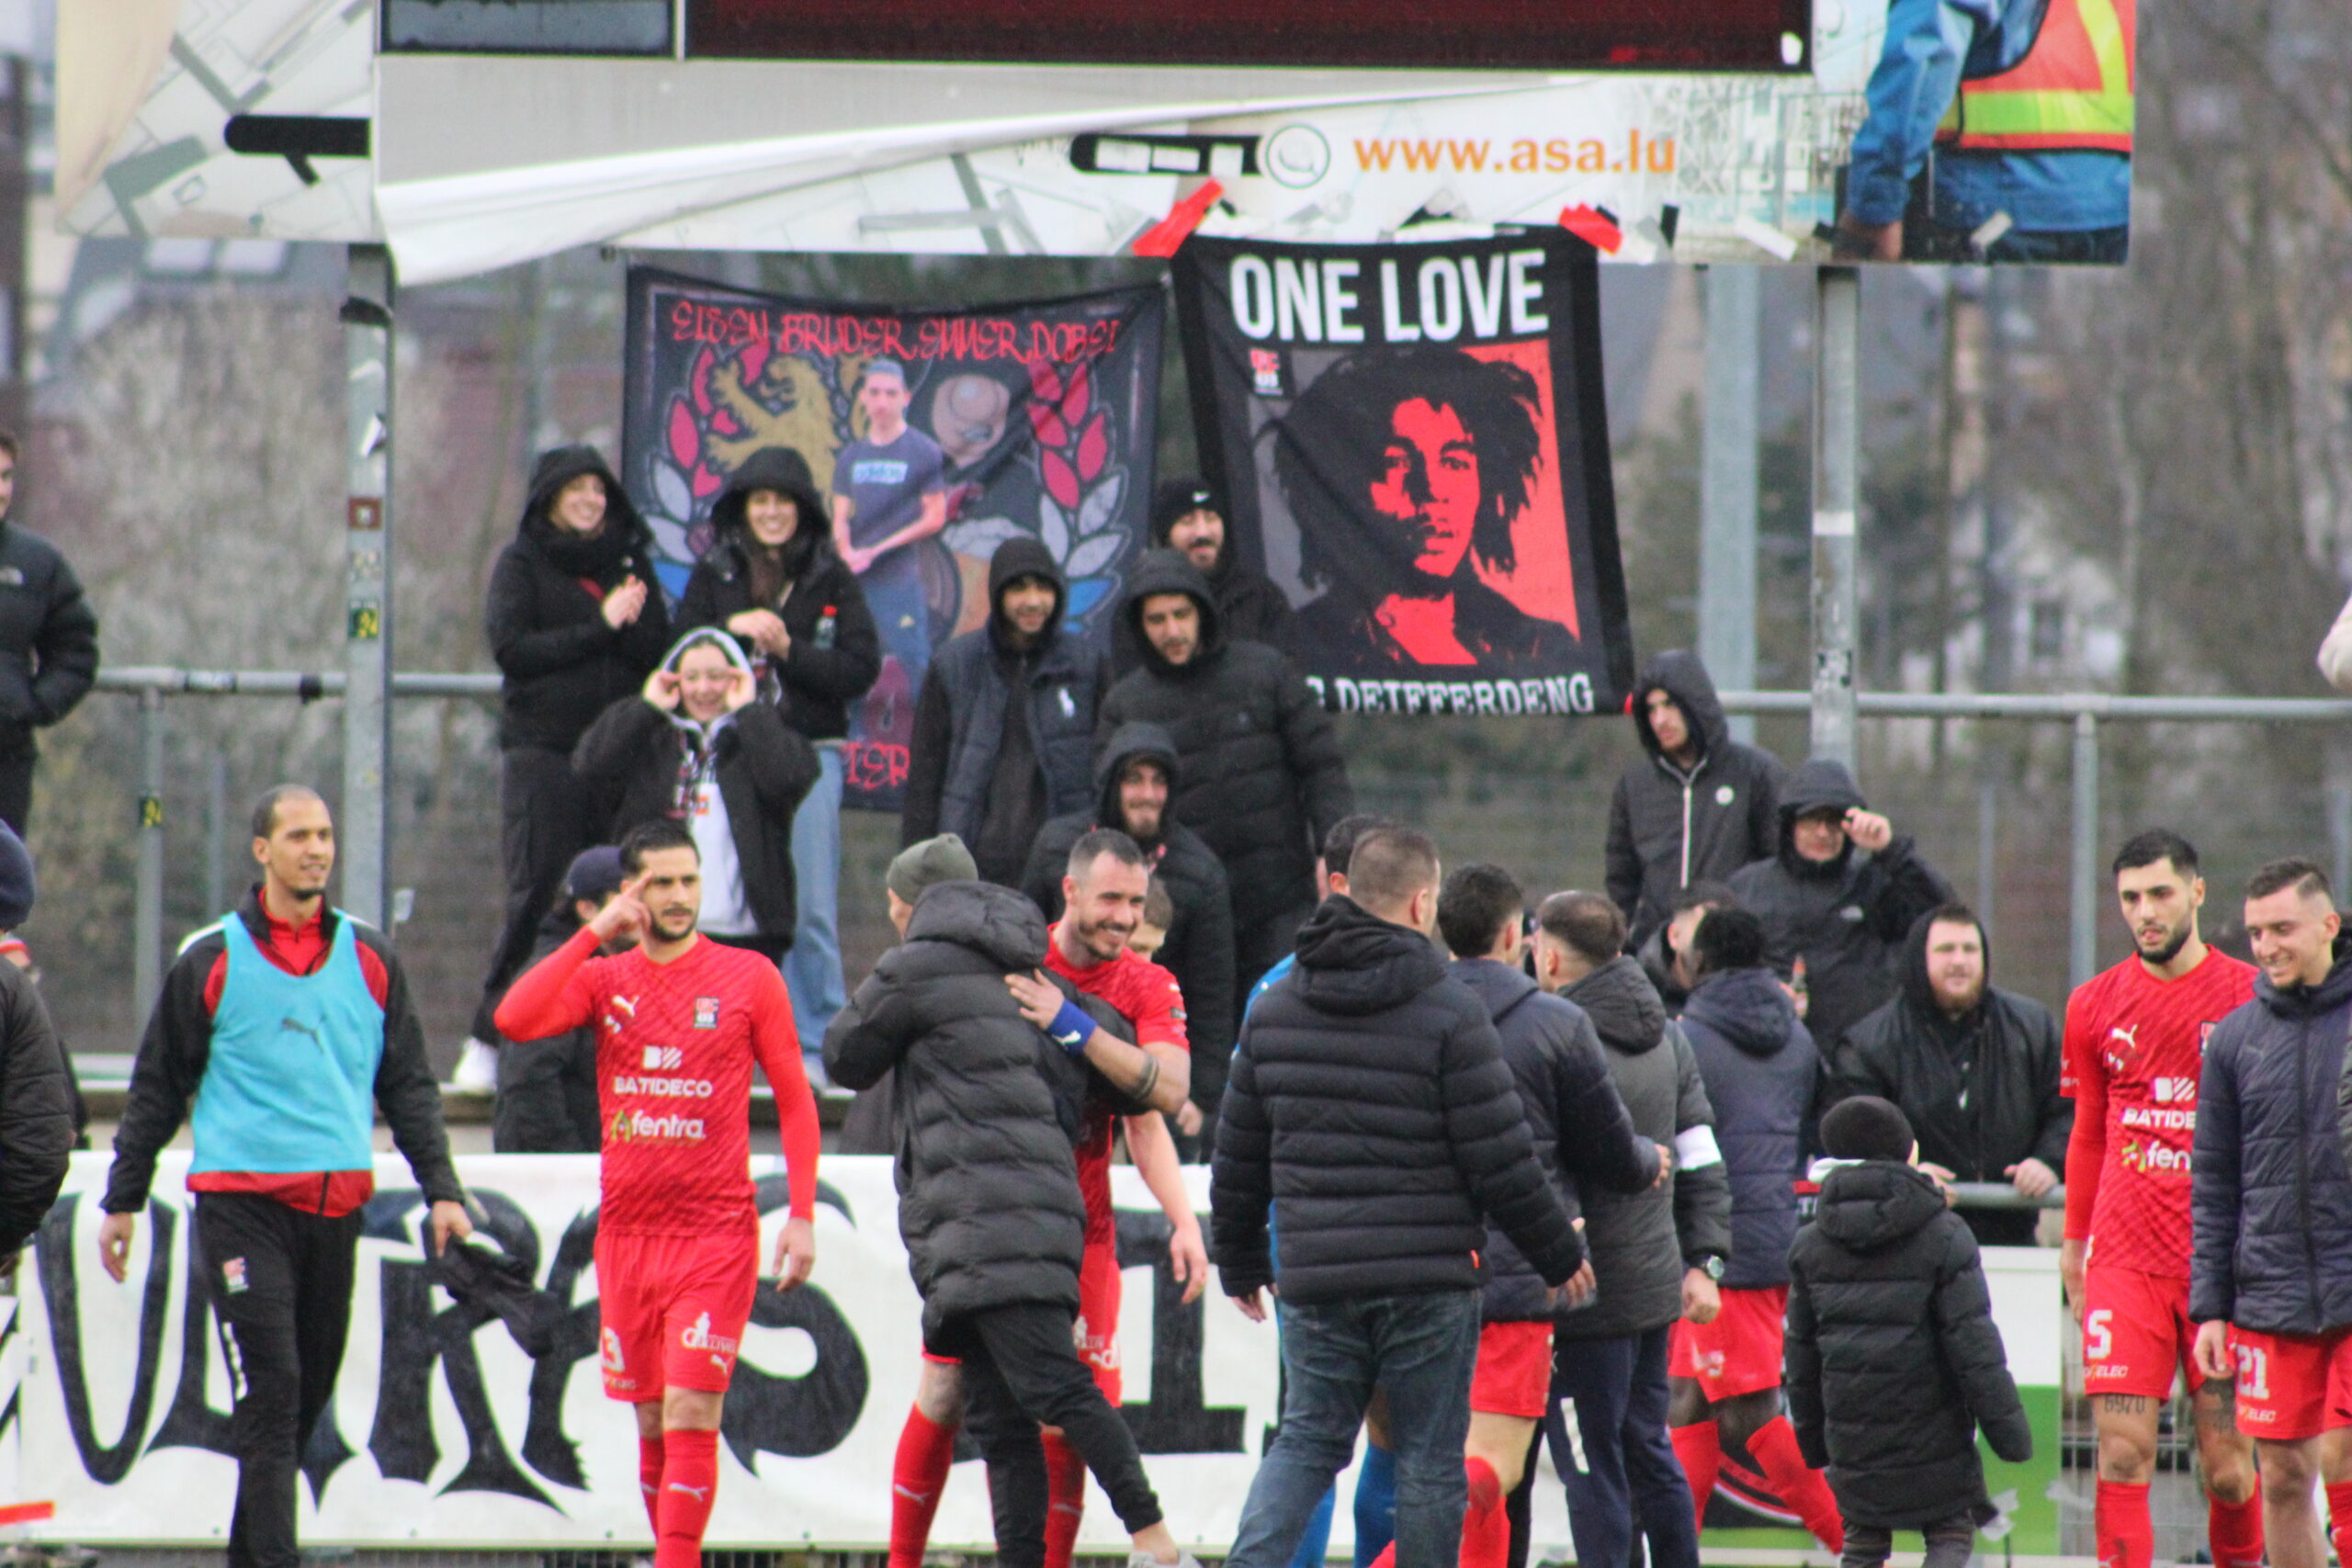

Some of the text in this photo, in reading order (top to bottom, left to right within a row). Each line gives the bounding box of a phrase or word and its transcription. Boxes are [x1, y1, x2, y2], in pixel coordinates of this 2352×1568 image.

[1353, 129, 1676, 174] www.asa.lu
[1229, 250, 1549, 343] ONE LOVE
[614, 1076, 714, 1099] BATIDECO
[2086, 1309, 2113, 1359] 5
[2236, 1345, 2270, 1400] 21
